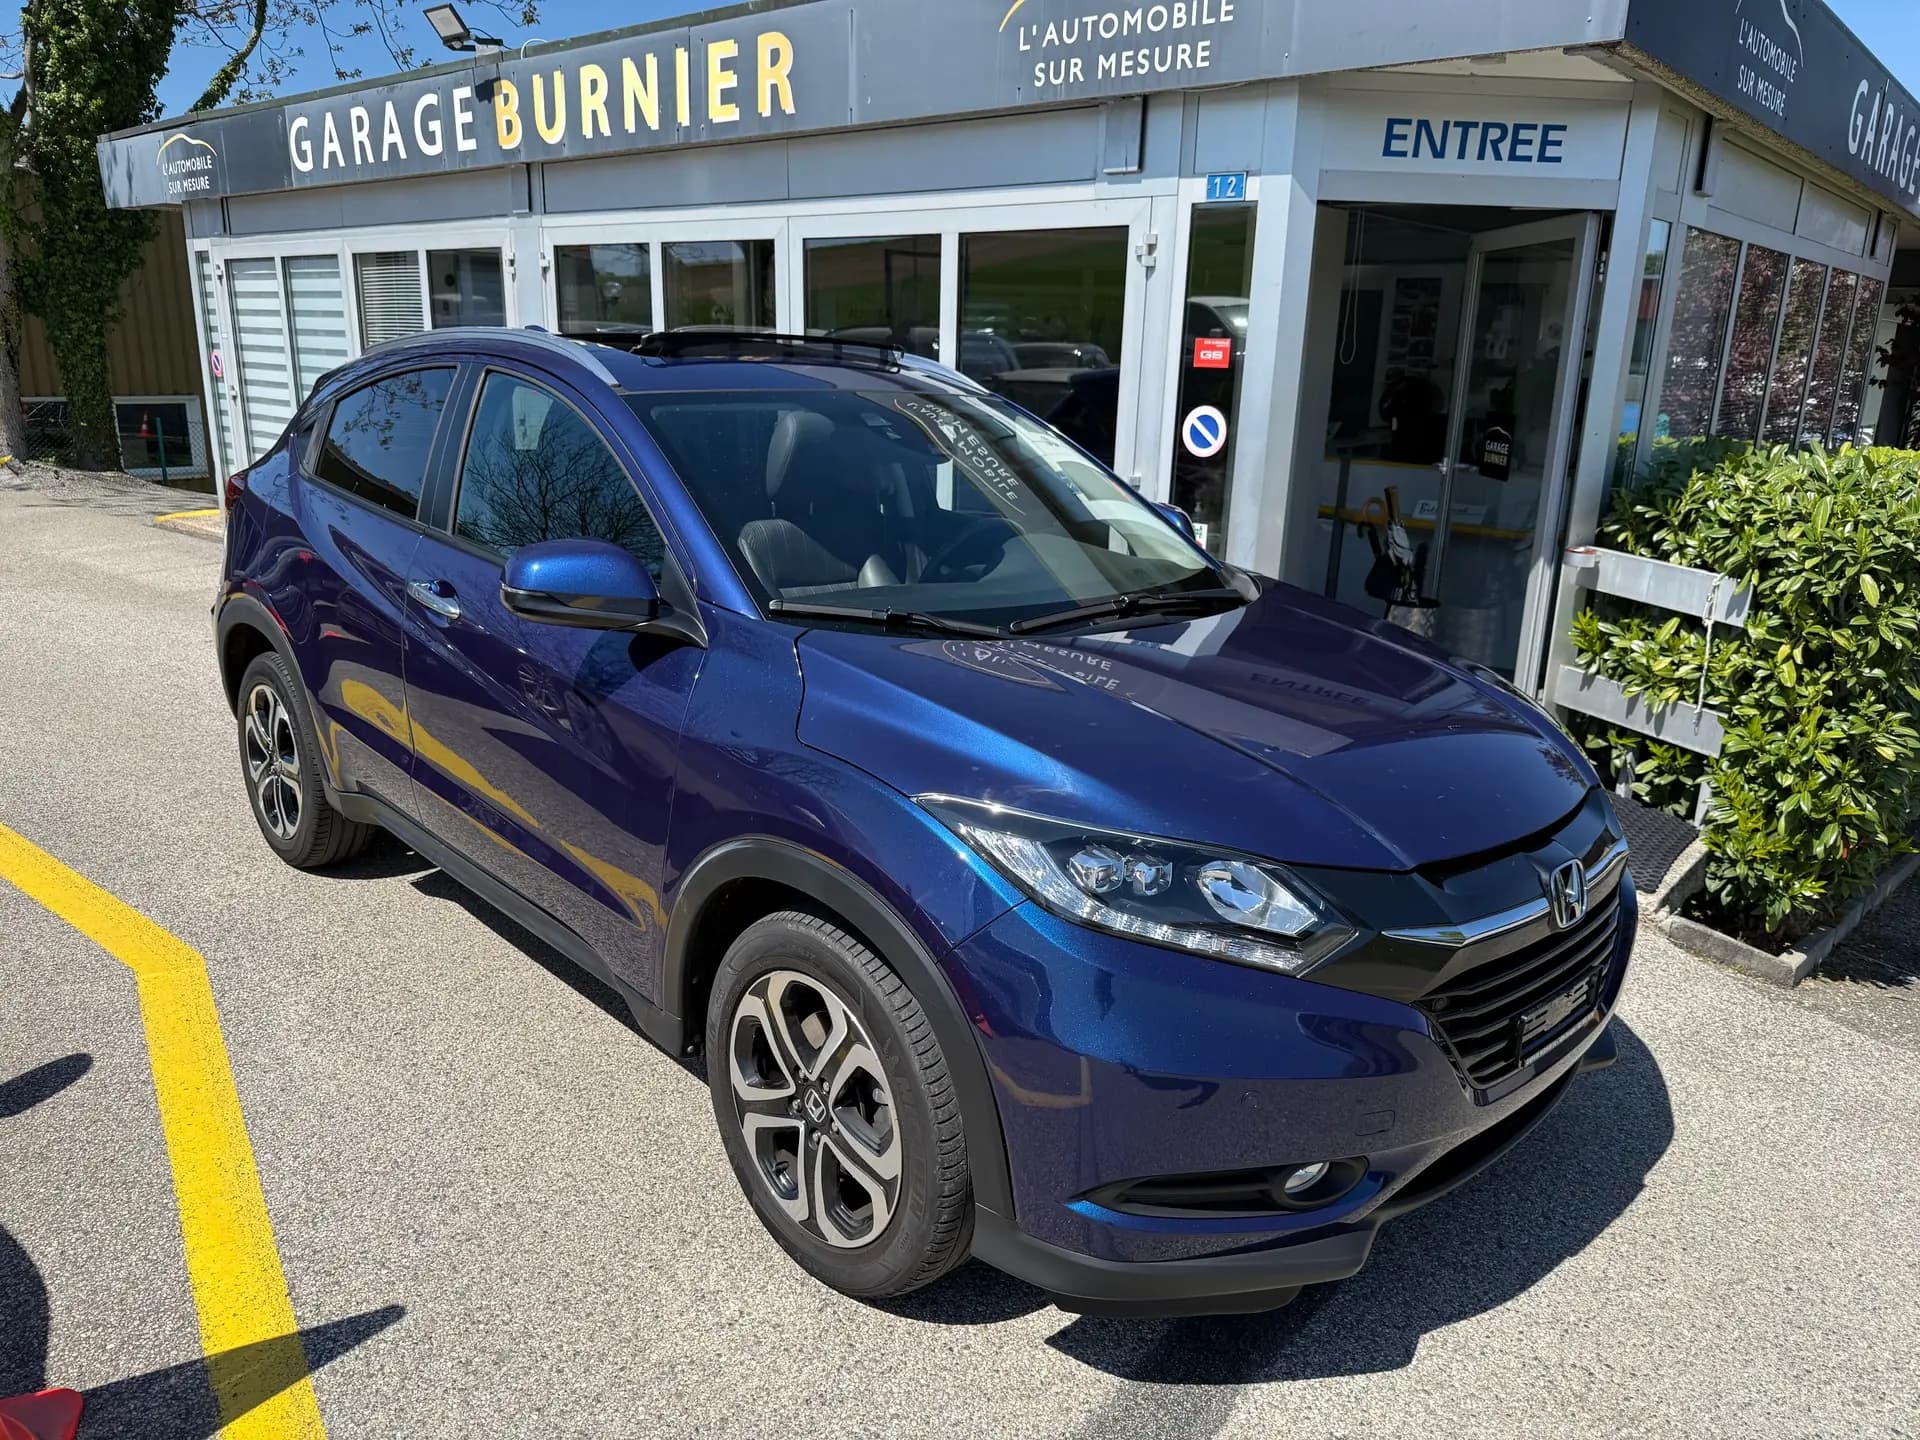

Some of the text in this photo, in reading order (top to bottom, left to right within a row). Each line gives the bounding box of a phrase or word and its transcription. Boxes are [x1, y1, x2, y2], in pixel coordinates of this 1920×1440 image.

[1019, 0, 1234, 51] L'AUTOMOBILE
[1033, 40, 1211, 87] SUR MESURE
[1738, 18, 1798, 83] L'AUTOMOBILE
[288, 31, 796, 173] GARAGE BURNIER
[1737, 64, 1786, 117] SUR MESURE
[1382, 118, 1568, 163] ENTREE
[162, 155, 212, 176] L'AUTOMOBILE
[168, 175, 210, 194] SUR MESURE
[1214, 176, 1236, 197] 12
